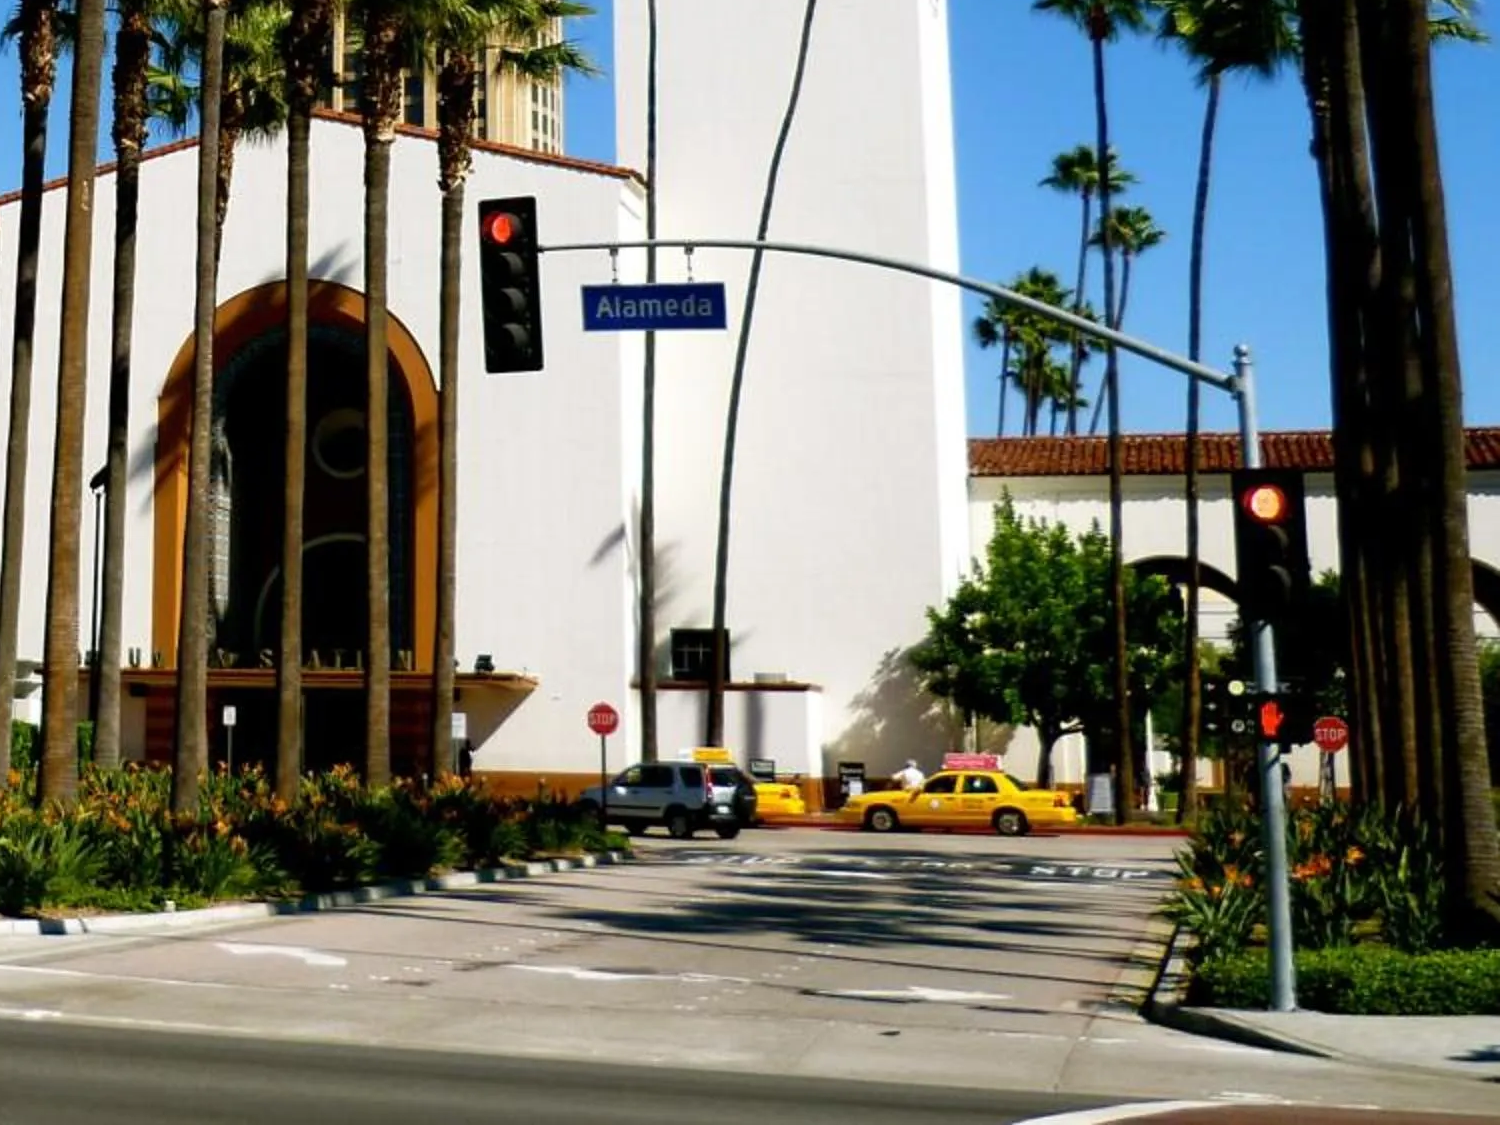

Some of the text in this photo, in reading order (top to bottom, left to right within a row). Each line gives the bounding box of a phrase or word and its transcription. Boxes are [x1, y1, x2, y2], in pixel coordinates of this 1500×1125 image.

[596, 294, 713, 318] Alameda
[588, 712, 614, 725] STOP
[1314, 728, 1347, 741] STOP
